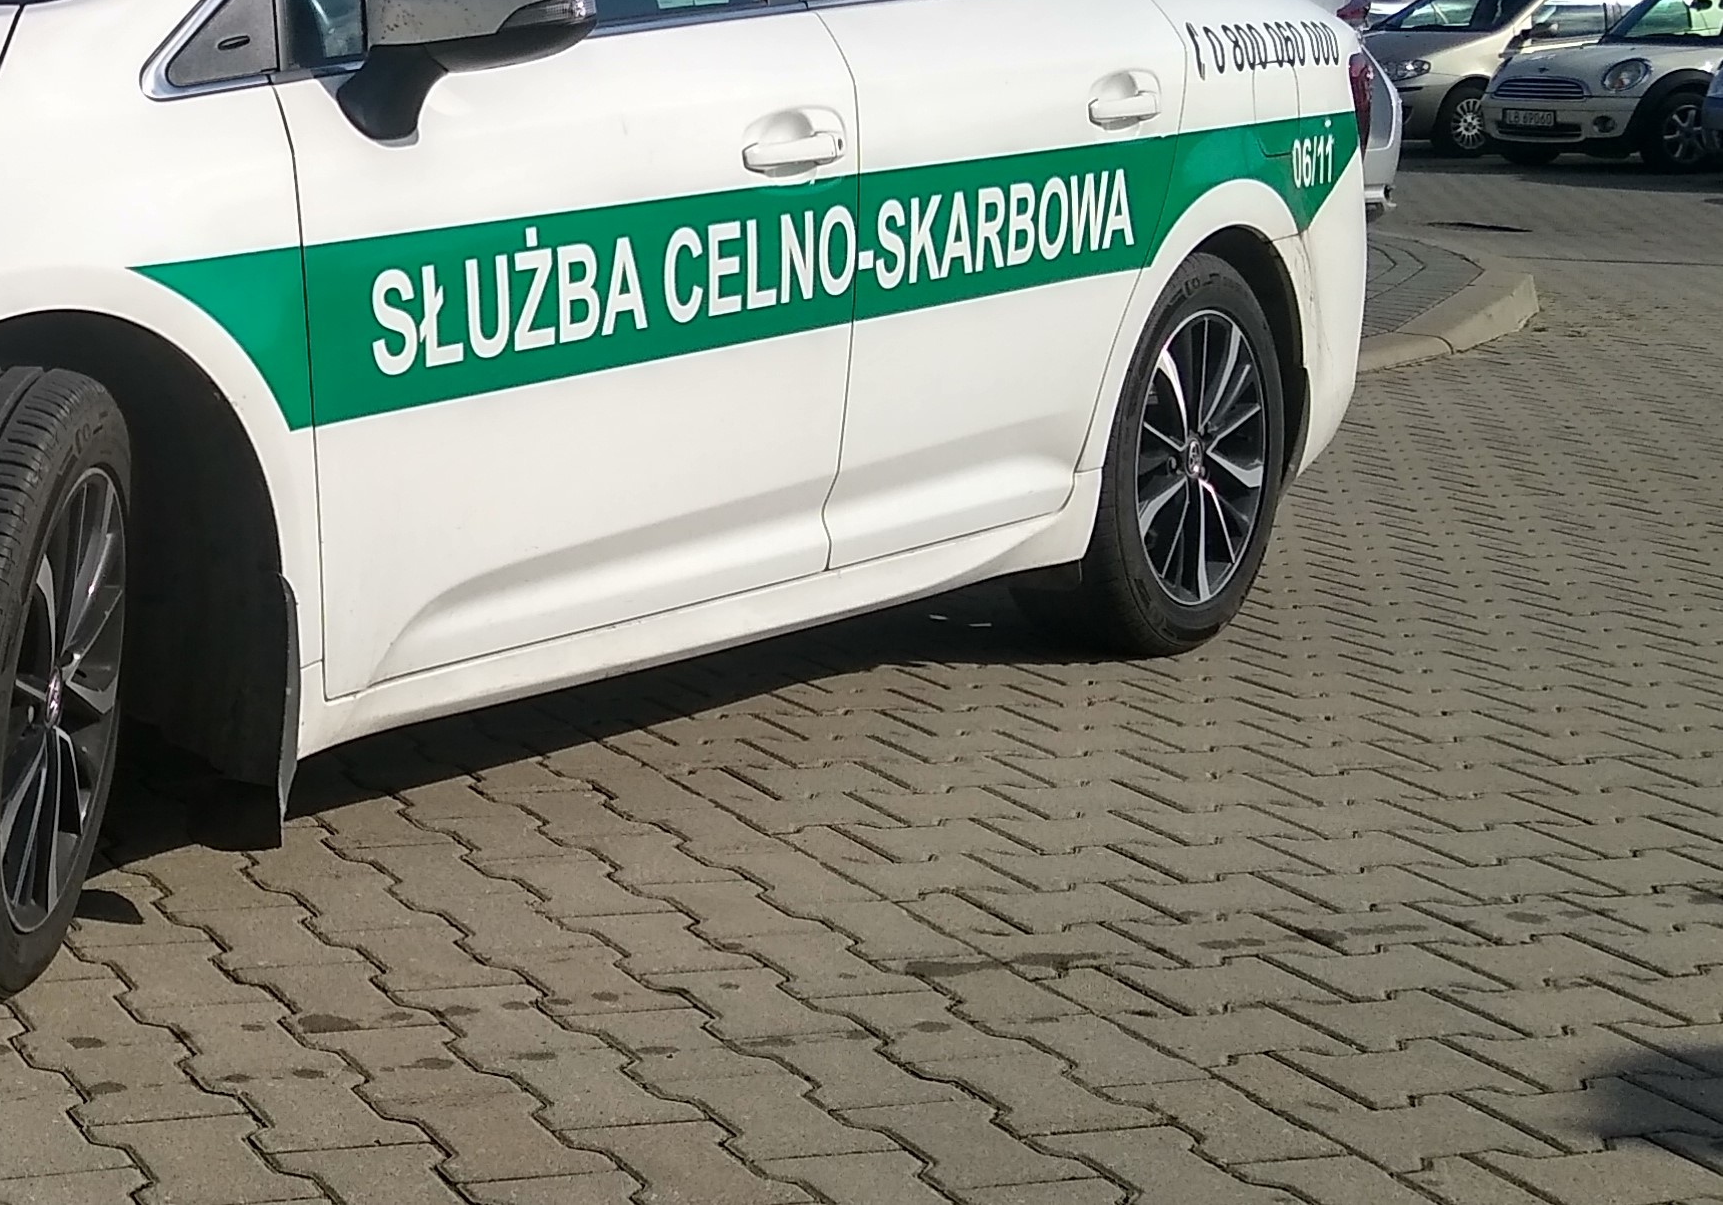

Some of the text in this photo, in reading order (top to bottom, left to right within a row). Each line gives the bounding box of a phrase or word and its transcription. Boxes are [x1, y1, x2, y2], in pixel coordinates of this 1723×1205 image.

[1293, 134, 1333, 188] 06/11
[372, 169, 1135, 375] SŁUŻBA CELNO-SKARBOWA
